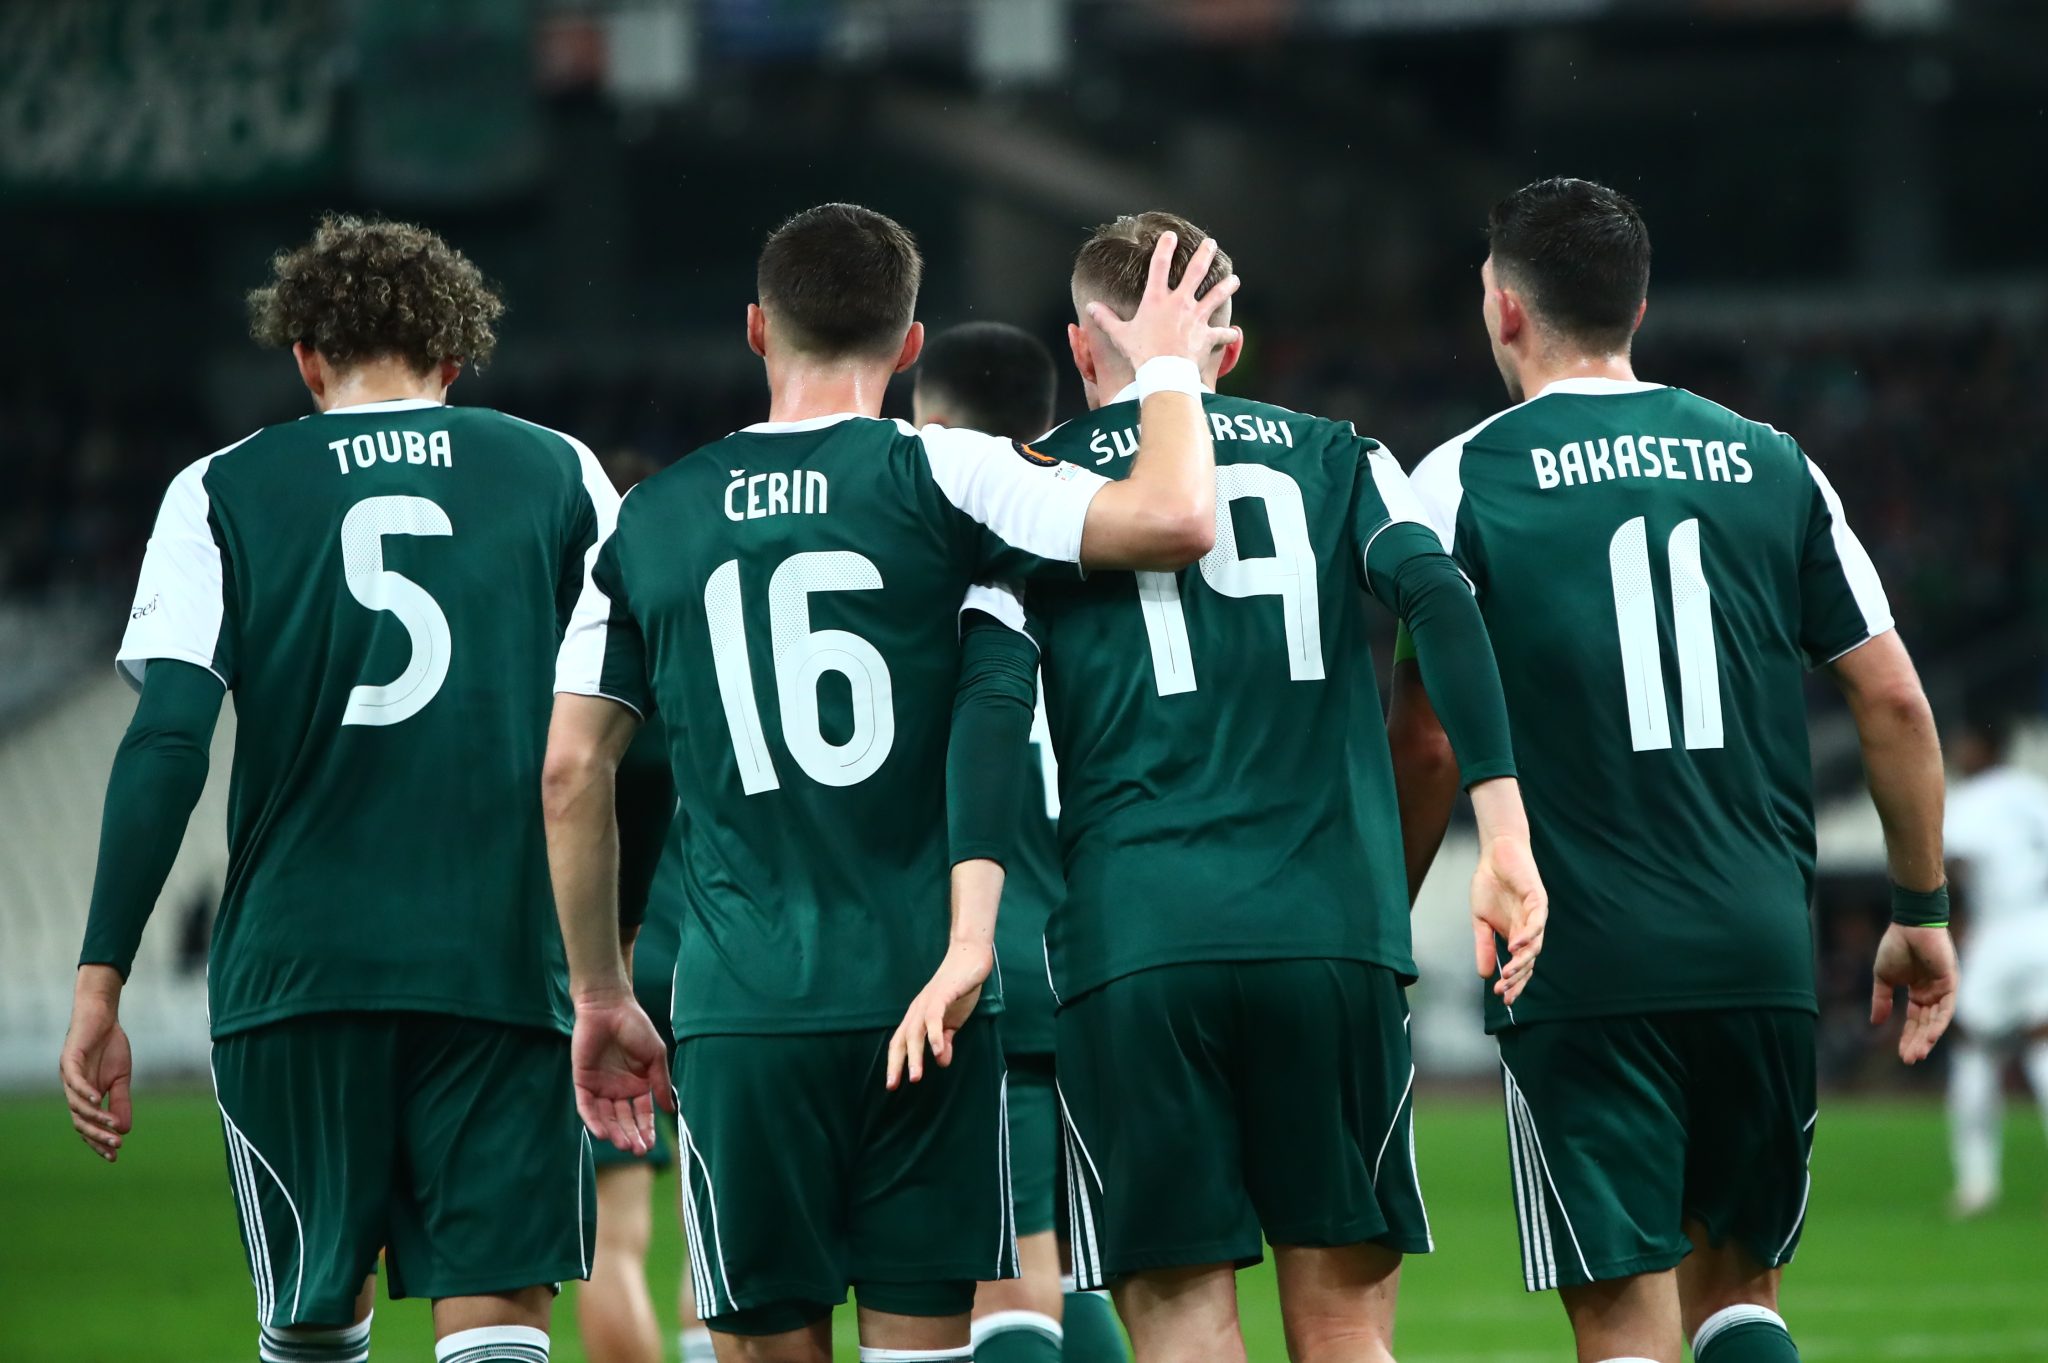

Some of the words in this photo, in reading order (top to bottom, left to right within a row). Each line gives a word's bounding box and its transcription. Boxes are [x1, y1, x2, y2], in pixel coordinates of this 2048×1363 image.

[328, 430, 453, 475] TOUBA
[1090, 412, 1293, 466] ŚWRSKI
[1530, 434, 1753, 490] BAKASETAS
[724, 469, 828, 522] ČERIN
[340, 494, 453, 726] 5
[1608, 515, 1724, 752] 11
[703, 550, 895, 796] 16
